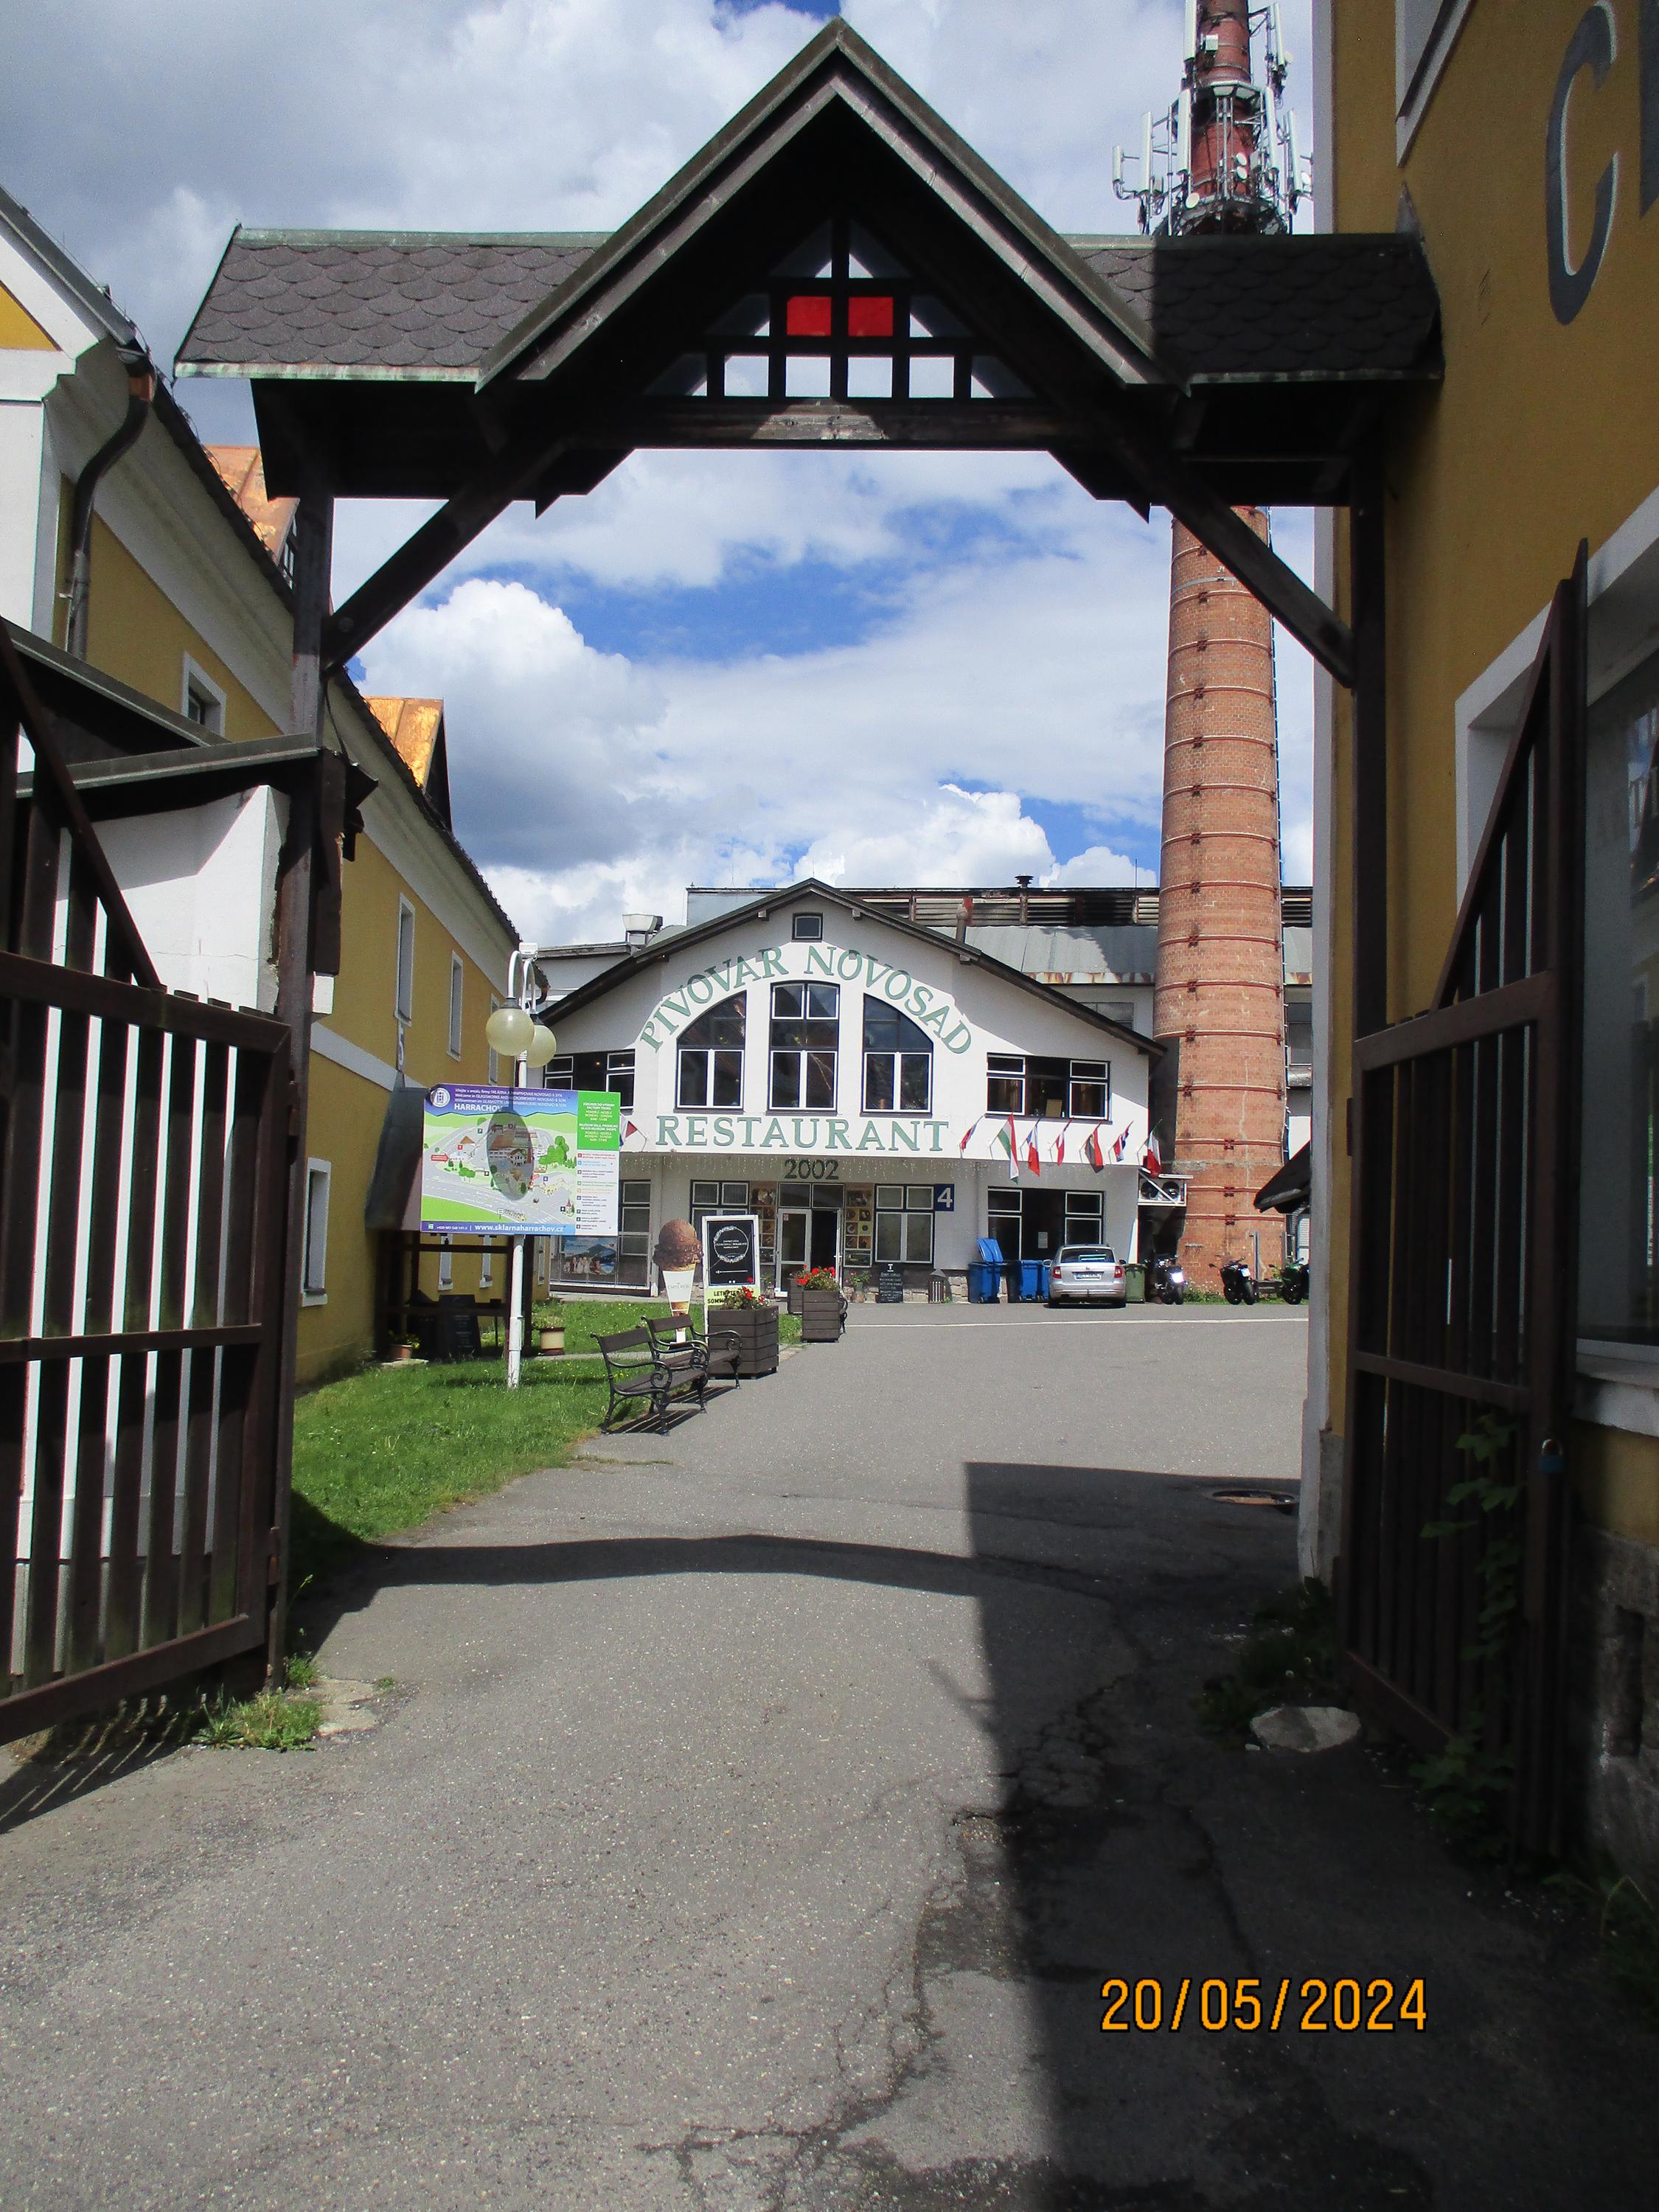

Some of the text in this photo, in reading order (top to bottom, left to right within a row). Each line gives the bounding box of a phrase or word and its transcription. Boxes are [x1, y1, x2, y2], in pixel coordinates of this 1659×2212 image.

[639, 945, 972, 1054] PIVOVAR NOVOSAD
[454, 1103, 502, 1112] HARRACHOV
[655, 1116, 949, 1152] RESTAURANT
[784, 1159, 839, 1180] 2002
[937, 1187, 953, 1208] 4
[474, 1224, 564, 1232] www.sklarnaharrachov.cz
